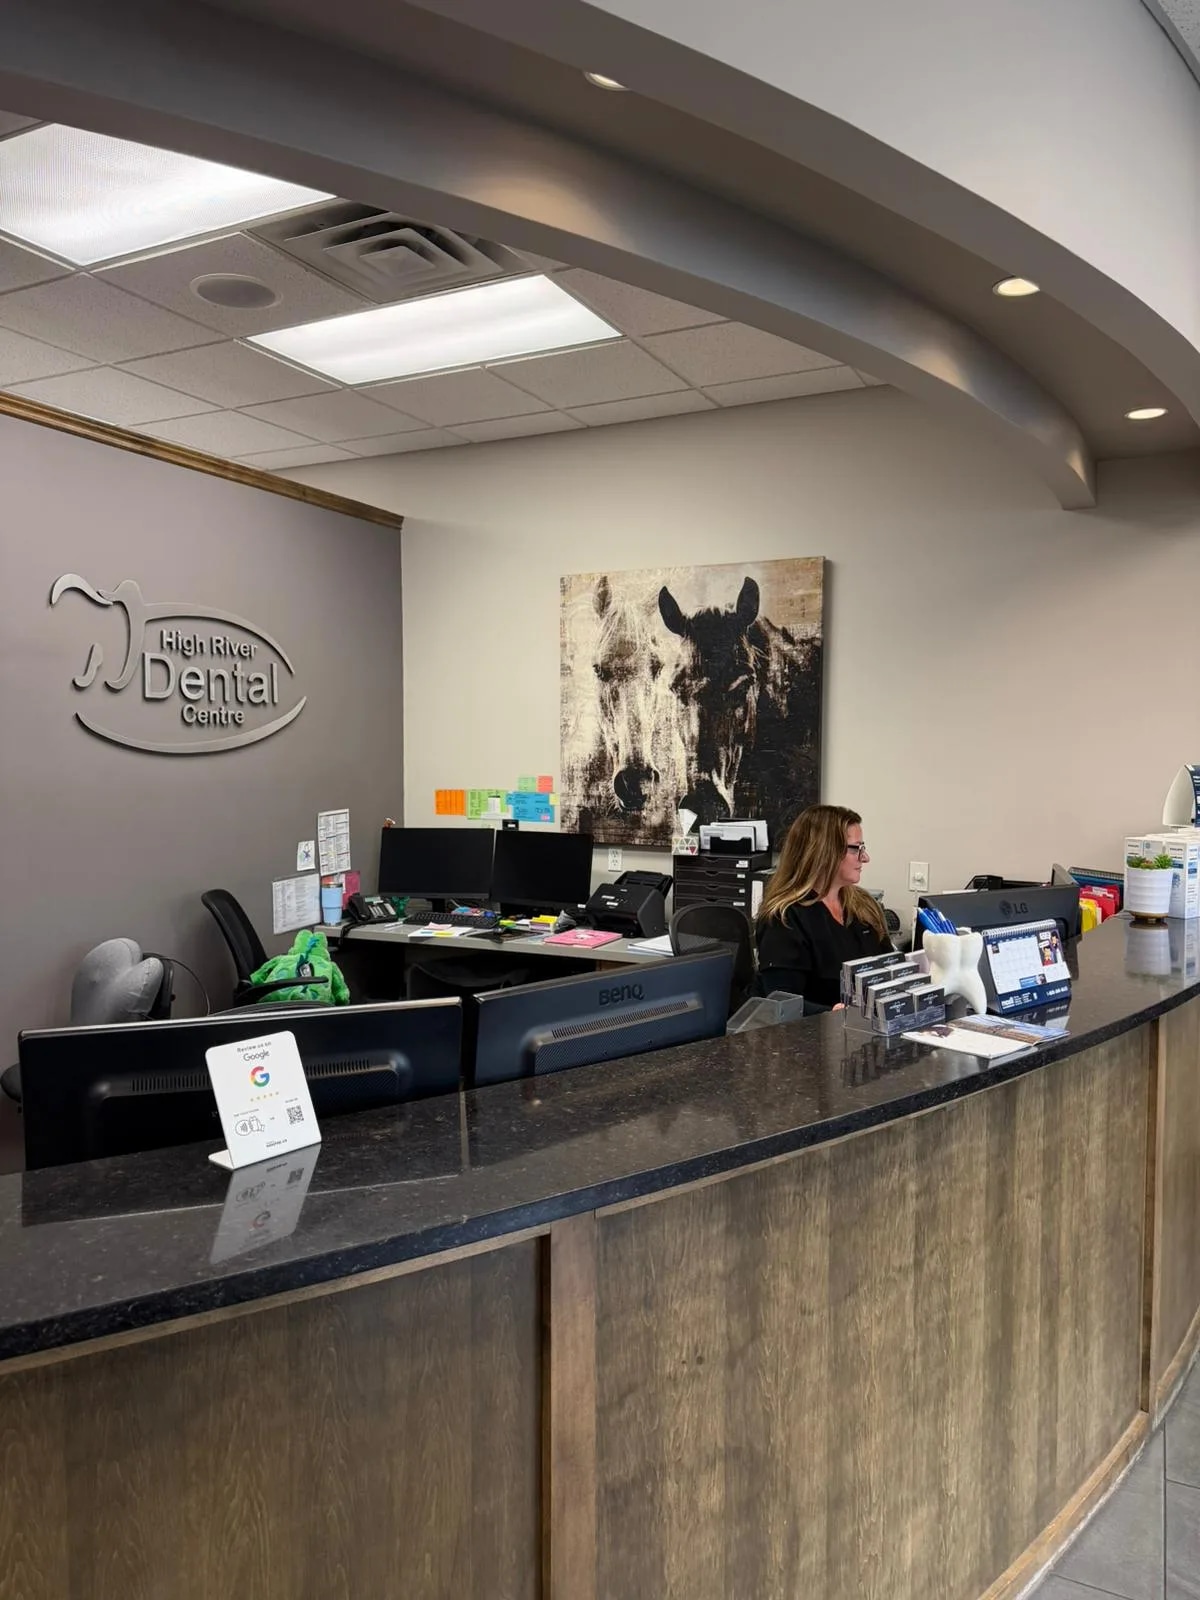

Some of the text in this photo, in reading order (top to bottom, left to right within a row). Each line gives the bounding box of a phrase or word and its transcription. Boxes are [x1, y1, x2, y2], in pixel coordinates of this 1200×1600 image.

[160, 629, 258, 658] High River
[142, 651, 279, 704] Dental
[180, 703, 246, 726] Centre
[1014, 902, 1029, 914] LG
[243, 1049, 270, 1062] Google
